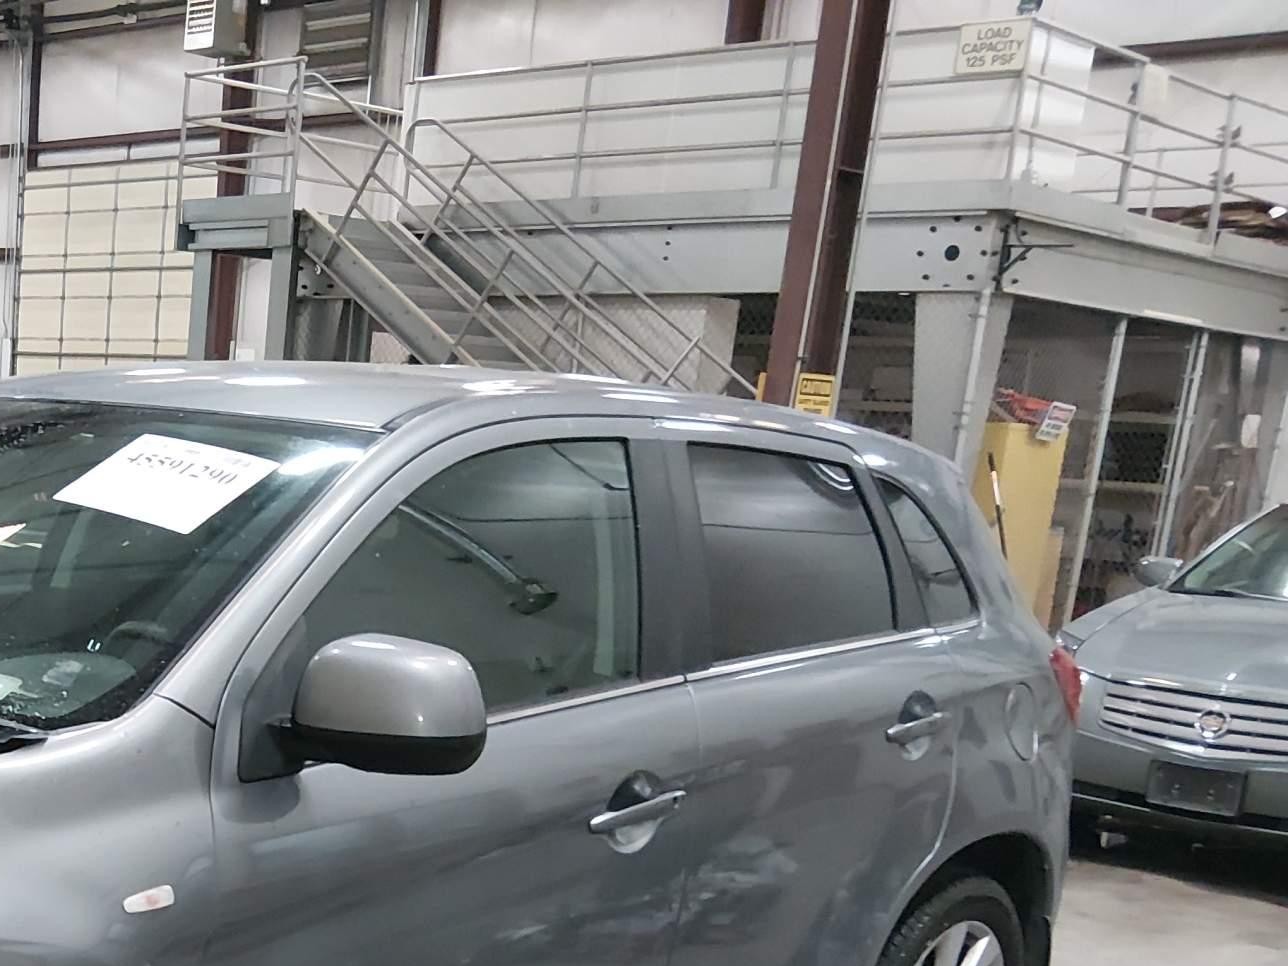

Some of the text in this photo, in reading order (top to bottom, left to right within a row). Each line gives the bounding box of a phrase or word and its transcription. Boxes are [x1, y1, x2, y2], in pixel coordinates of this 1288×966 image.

[977, 26, 1013, 40] LOAD
[962, 39, 1024, 55] CAPACITY
[966, 52, 1017, 68] 125 PSF
[127, 452, 238, 484] 45591290
